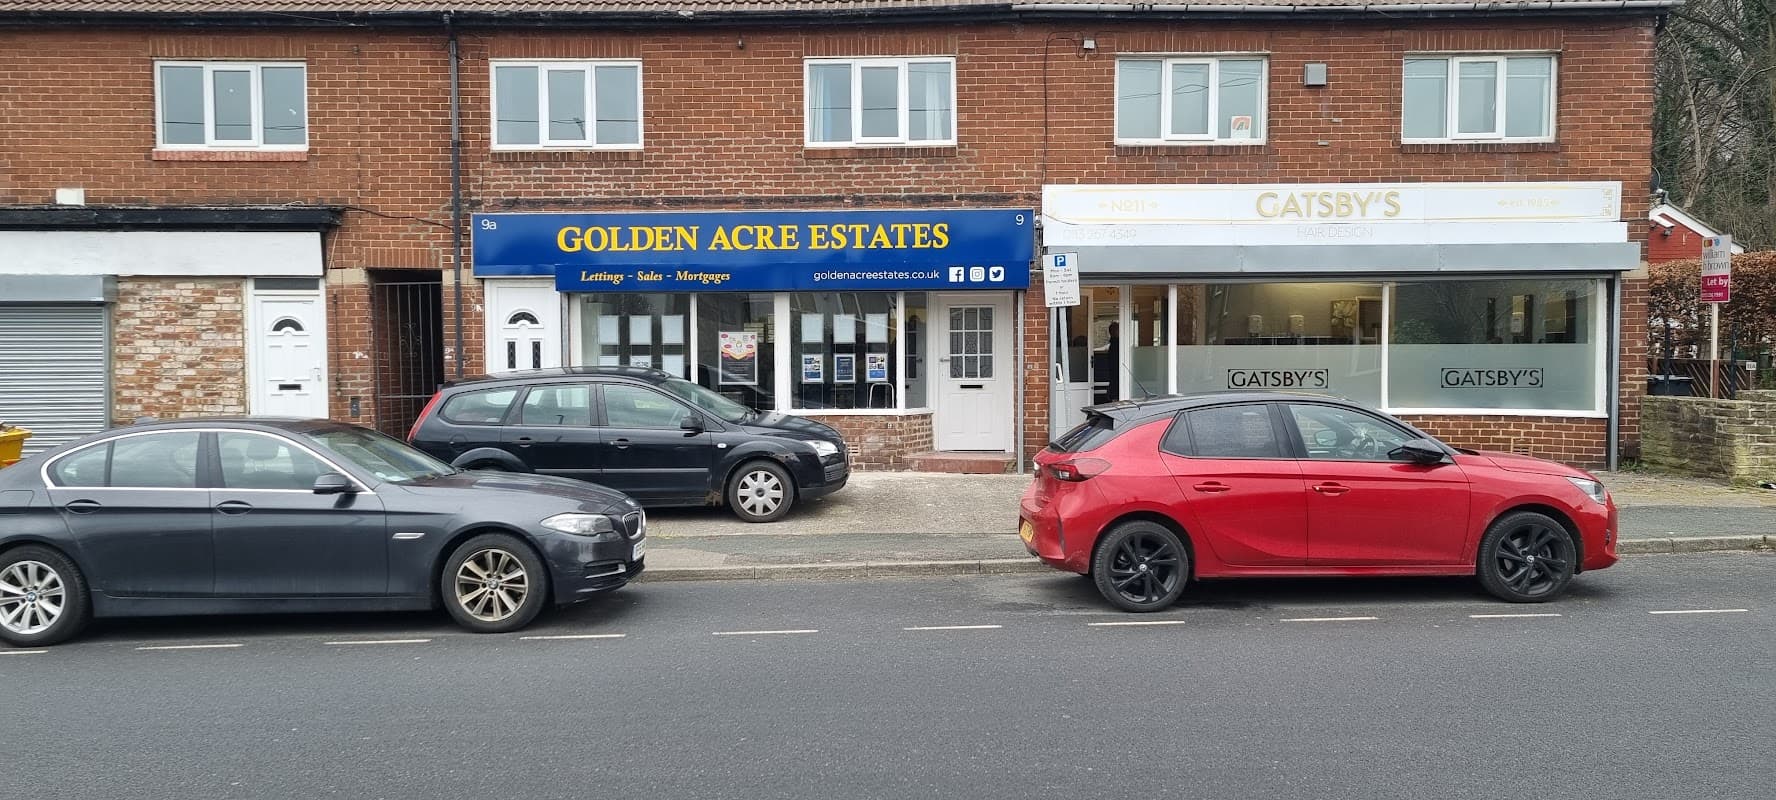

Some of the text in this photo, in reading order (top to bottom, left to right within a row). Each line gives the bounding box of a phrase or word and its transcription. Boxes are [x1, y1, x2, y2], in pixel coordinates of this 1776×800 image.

[1256, 191, 1401, 218] GATSBY'S
[481, 219, 497, 231] 9a
[1015, 214, 1025, 226] 9
[556, 223, 949, 252] GOLDEN ACRE ESTATES
[1297, 225, 1374, 239] HAIR DESIGN
[1708, 258, 1730, 271] brown
[580, 271, 625, 284] Lettings
[637, 271, 663, 282] Sales
[675, 270, 731, 285] Mortgages
[813, 269, 940, 282] goldenacreestates.co.uk
[1707, 276, 1729, 288] Let by
[1231, 370, 1325, 387] GATSBY'S
[1445, 369, 1540, 386] GATSBY'S
